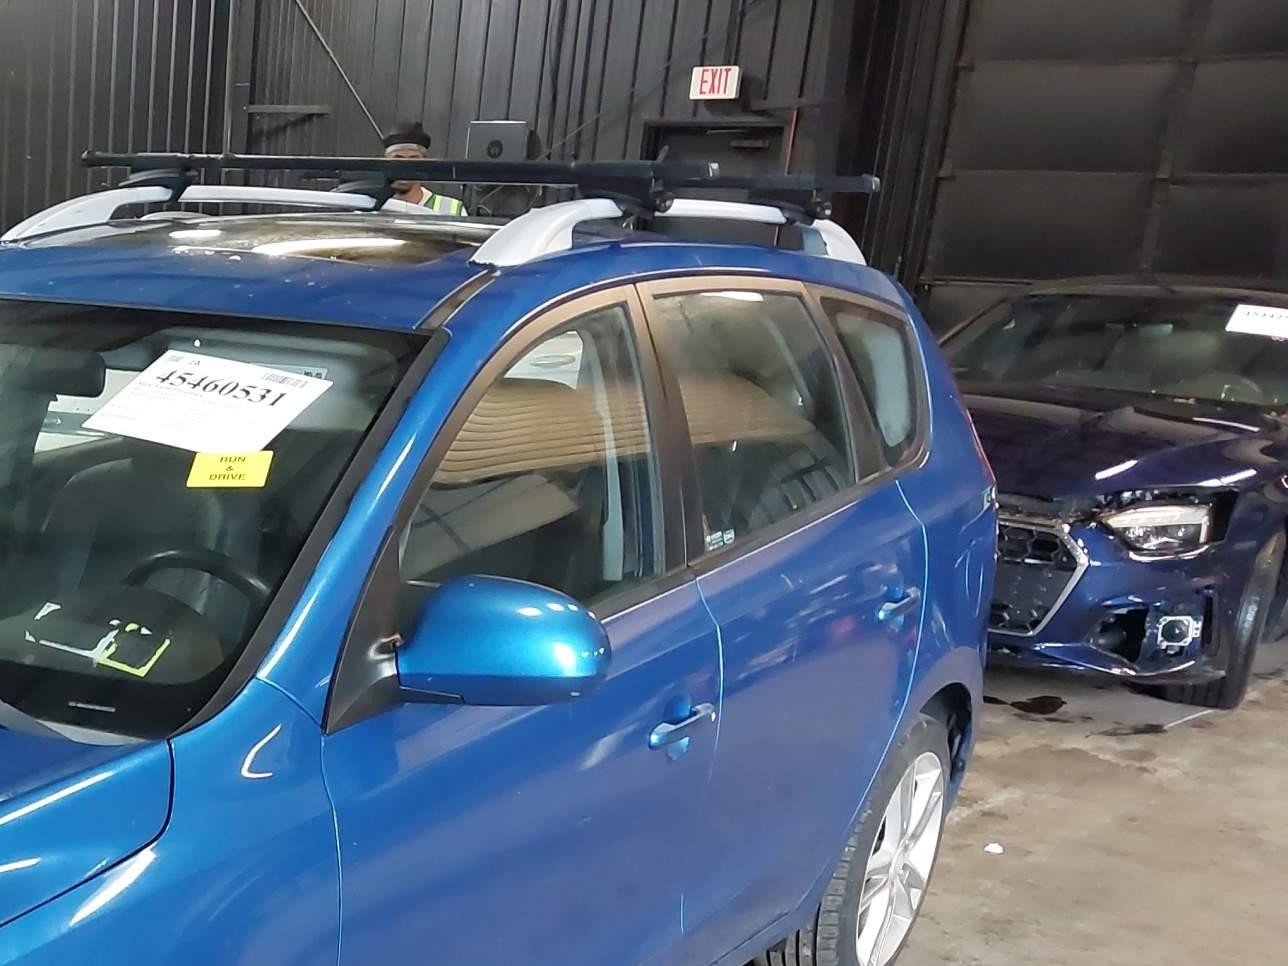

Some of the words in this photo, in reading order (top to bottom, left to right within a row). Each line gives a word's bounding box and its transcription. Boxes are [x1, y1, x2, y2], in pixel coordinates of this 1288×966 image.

[699, 67, 732, 95] EXIT
[156, 370, 287, 406] 45460531
[208, 473, 248, 481] DRIVE
[225, 464, 234, 472] &
